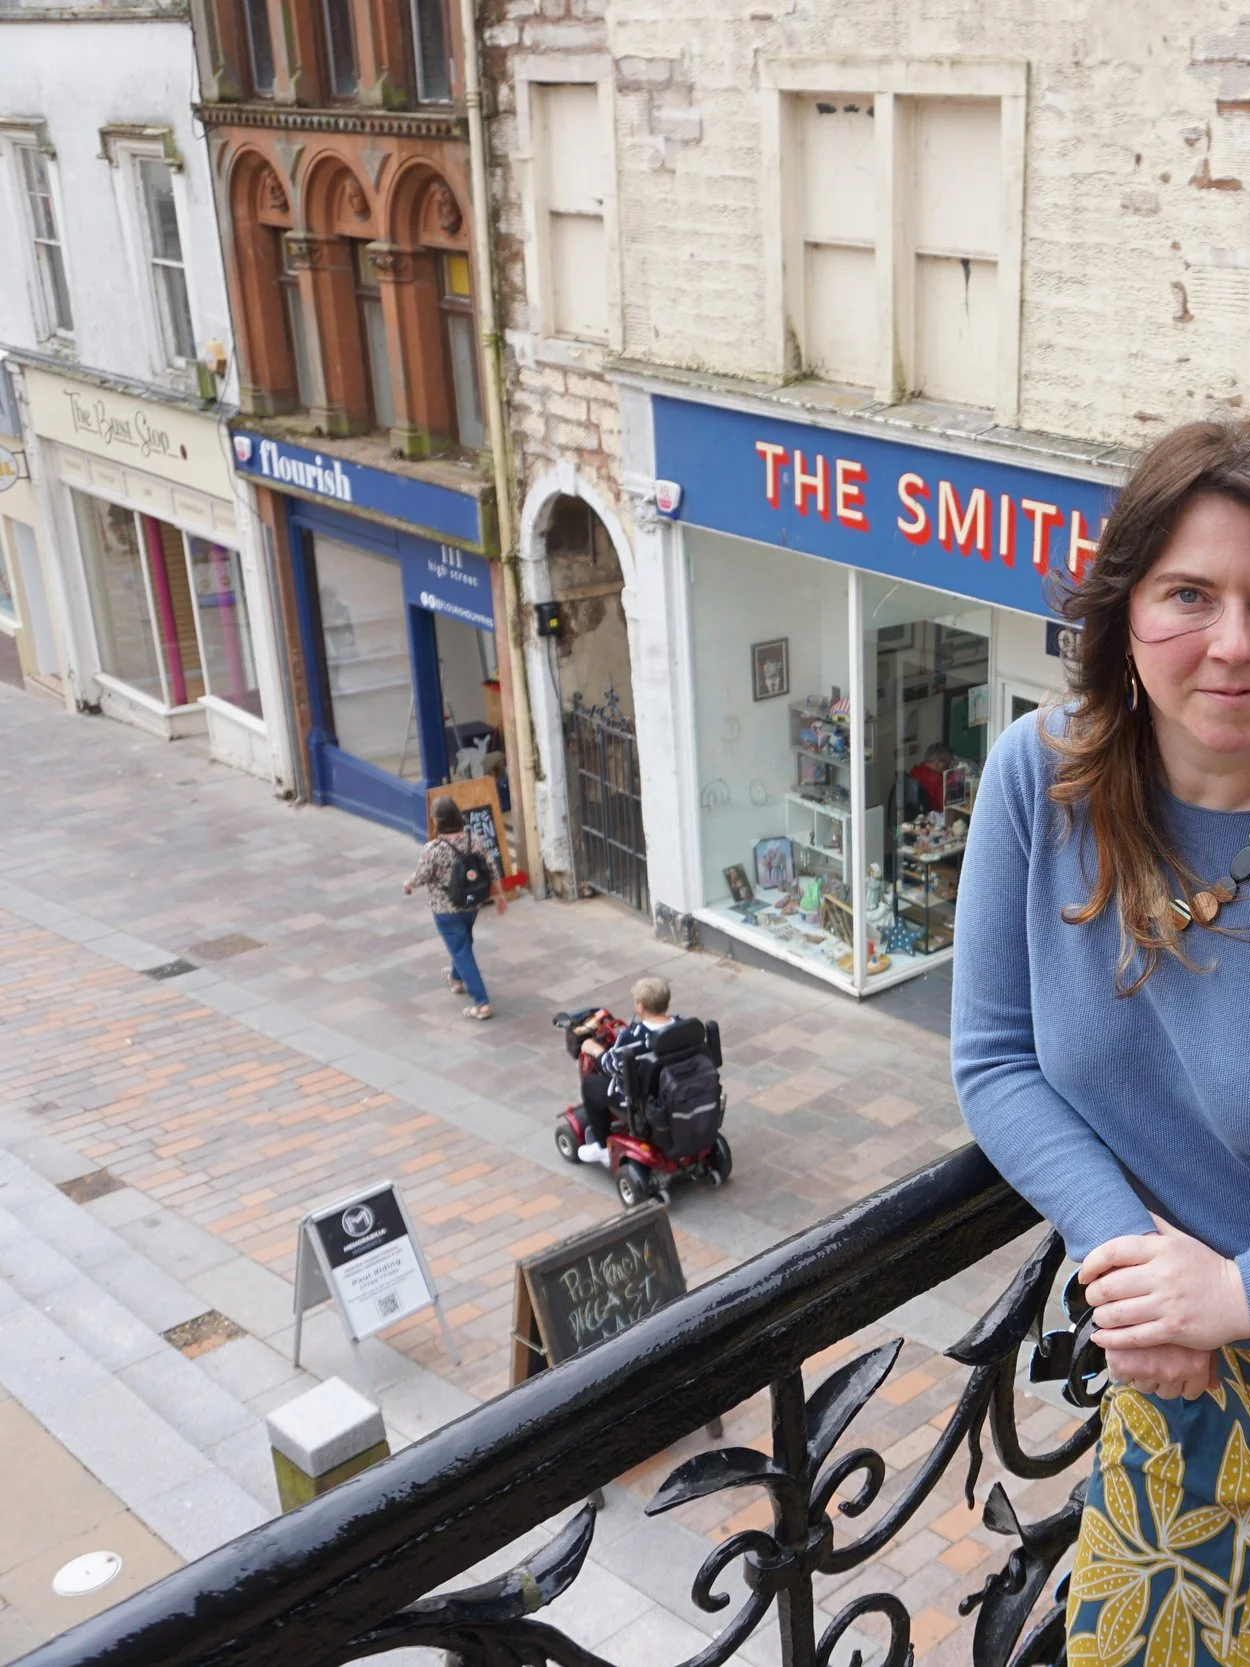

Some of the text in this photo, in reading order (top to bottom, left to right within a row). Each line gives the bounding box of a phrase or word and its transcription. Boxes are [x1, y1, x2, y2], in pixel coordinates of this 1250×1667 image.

[63, 390, 91, 433] The
[260, 439, 352, 501] flourish
[755, 440, 869, 533] THE
[428, 559, 478, 587] high street
